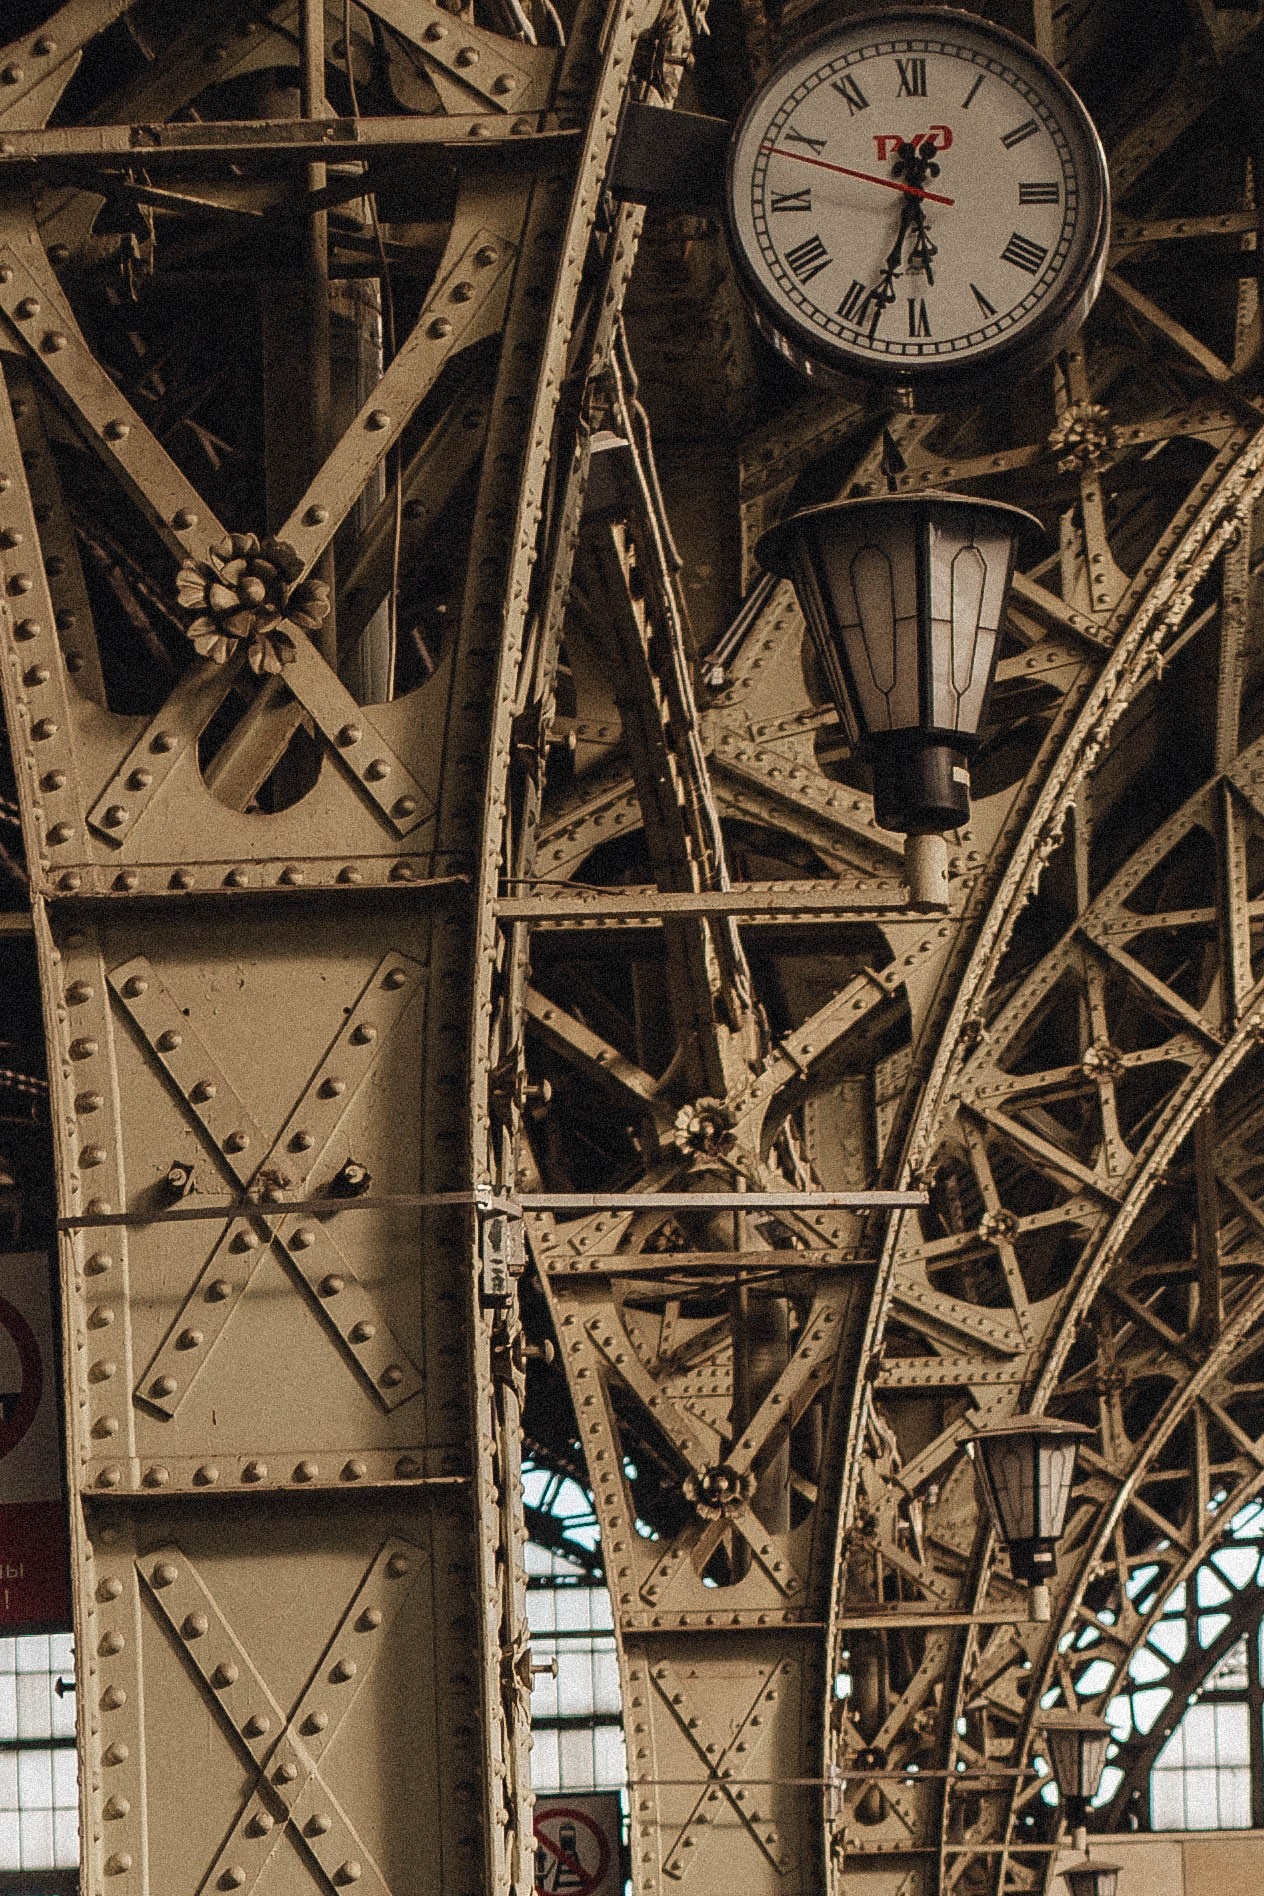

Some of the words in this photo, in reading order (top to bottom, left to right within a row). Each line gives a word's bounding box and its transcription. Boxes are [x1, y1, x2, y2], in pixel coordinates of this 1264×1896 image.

[831, 74, 869, 116] XI
[894, 58, 928, 97] XII
[961, 73, 986, 109] I
[784, 126, 827, 155] X
[1000, 118, 1040, 150] II
[771, 188, 812, 213] IX
[1018, 181, 1059, 205] III
[784, 234, 834, 285] VIII
[907, 298, 932, 337] VI
[969, 282, 998, 320] V
